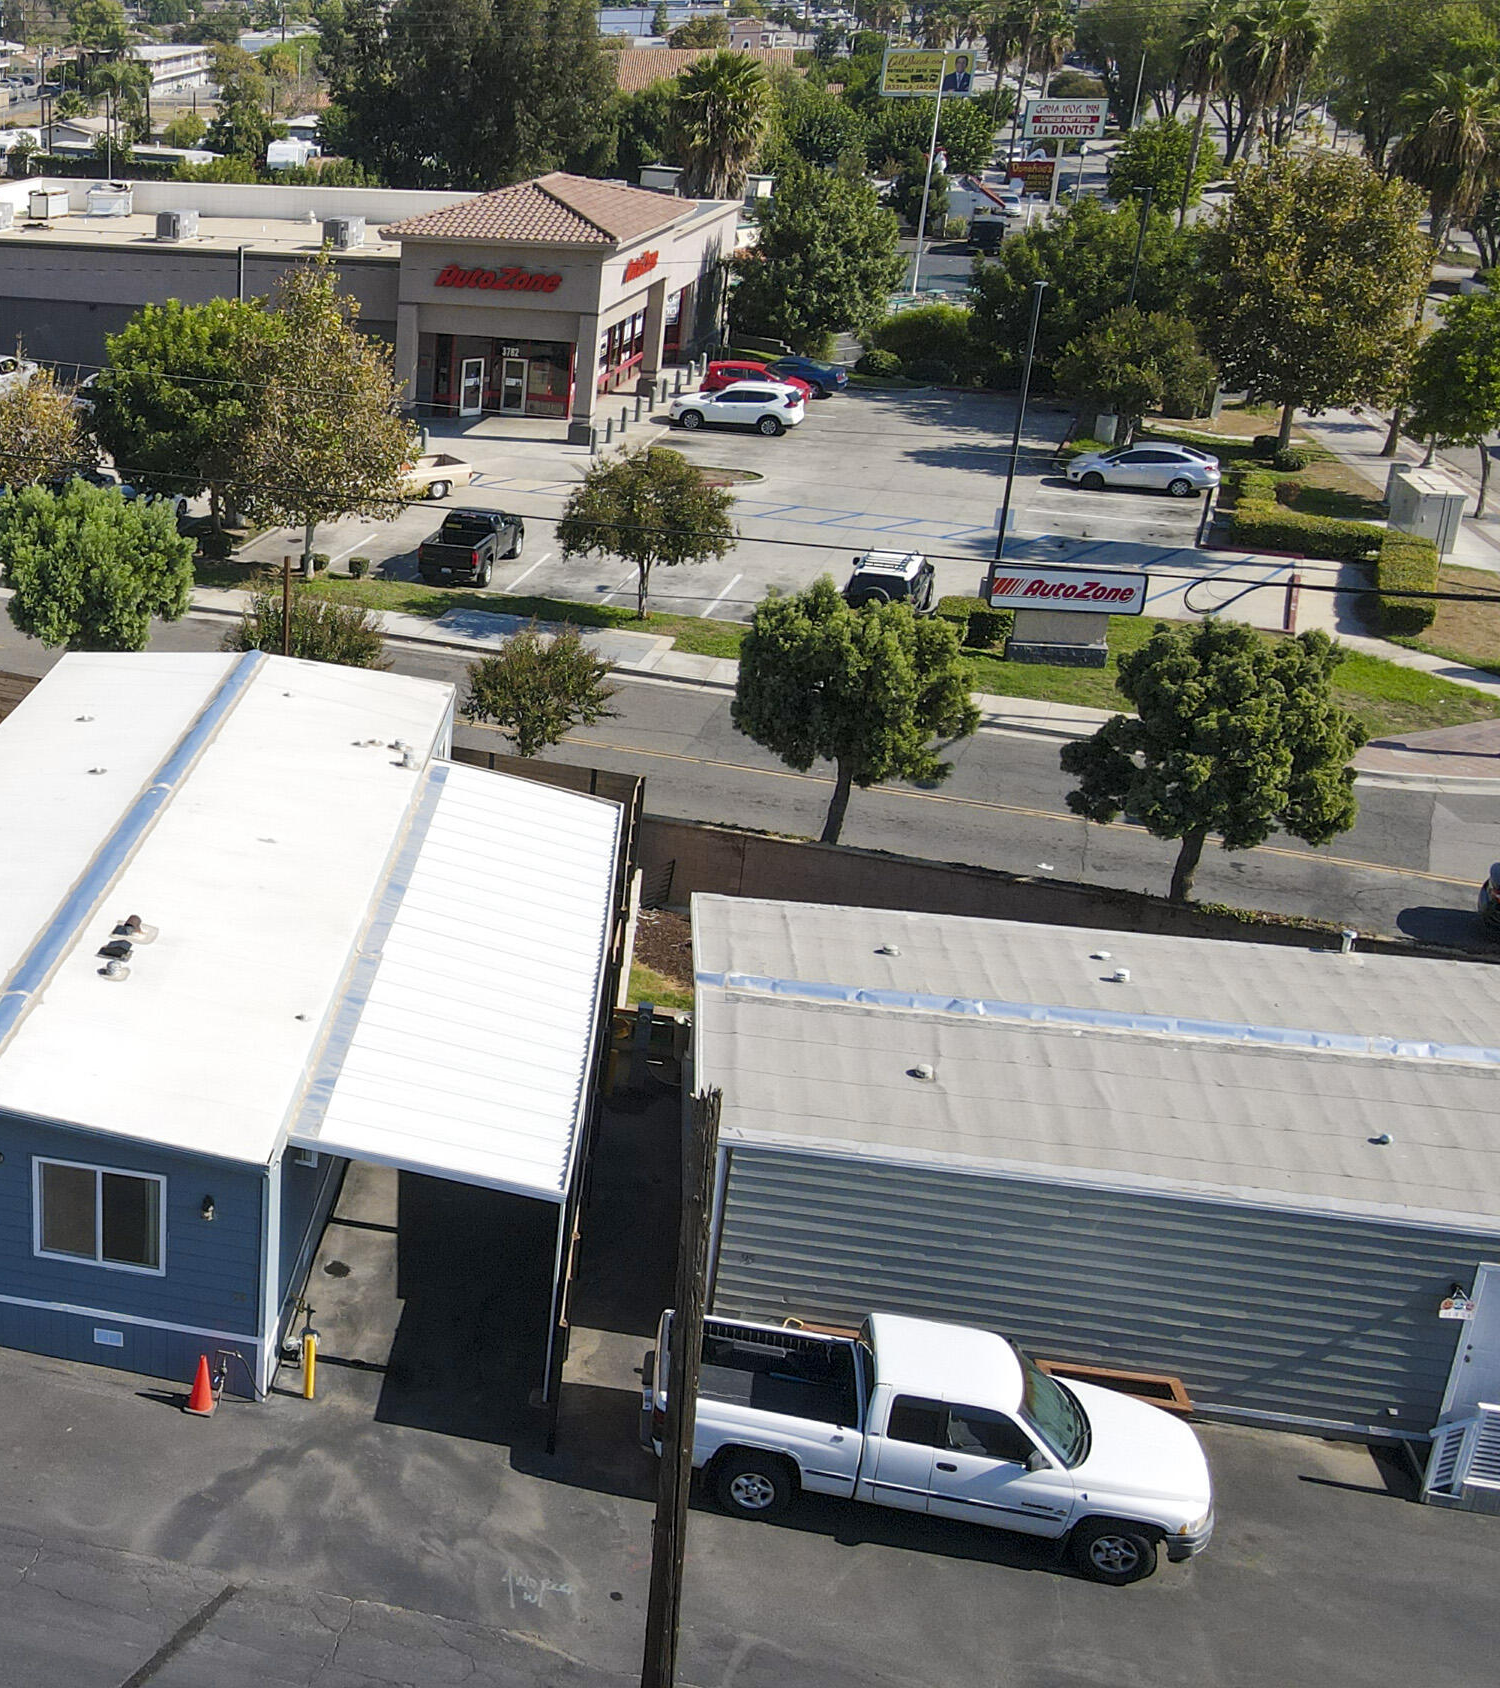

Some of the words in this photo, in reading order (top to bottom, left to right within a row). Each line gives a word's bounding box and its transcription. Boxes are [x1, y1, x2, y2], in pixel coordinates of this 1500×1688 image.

[1051, 125, 1096, 135] DONUTS
[434, 264, 563, 293] AutoZone
[1022, 579, 1136, 603] AutoZone
